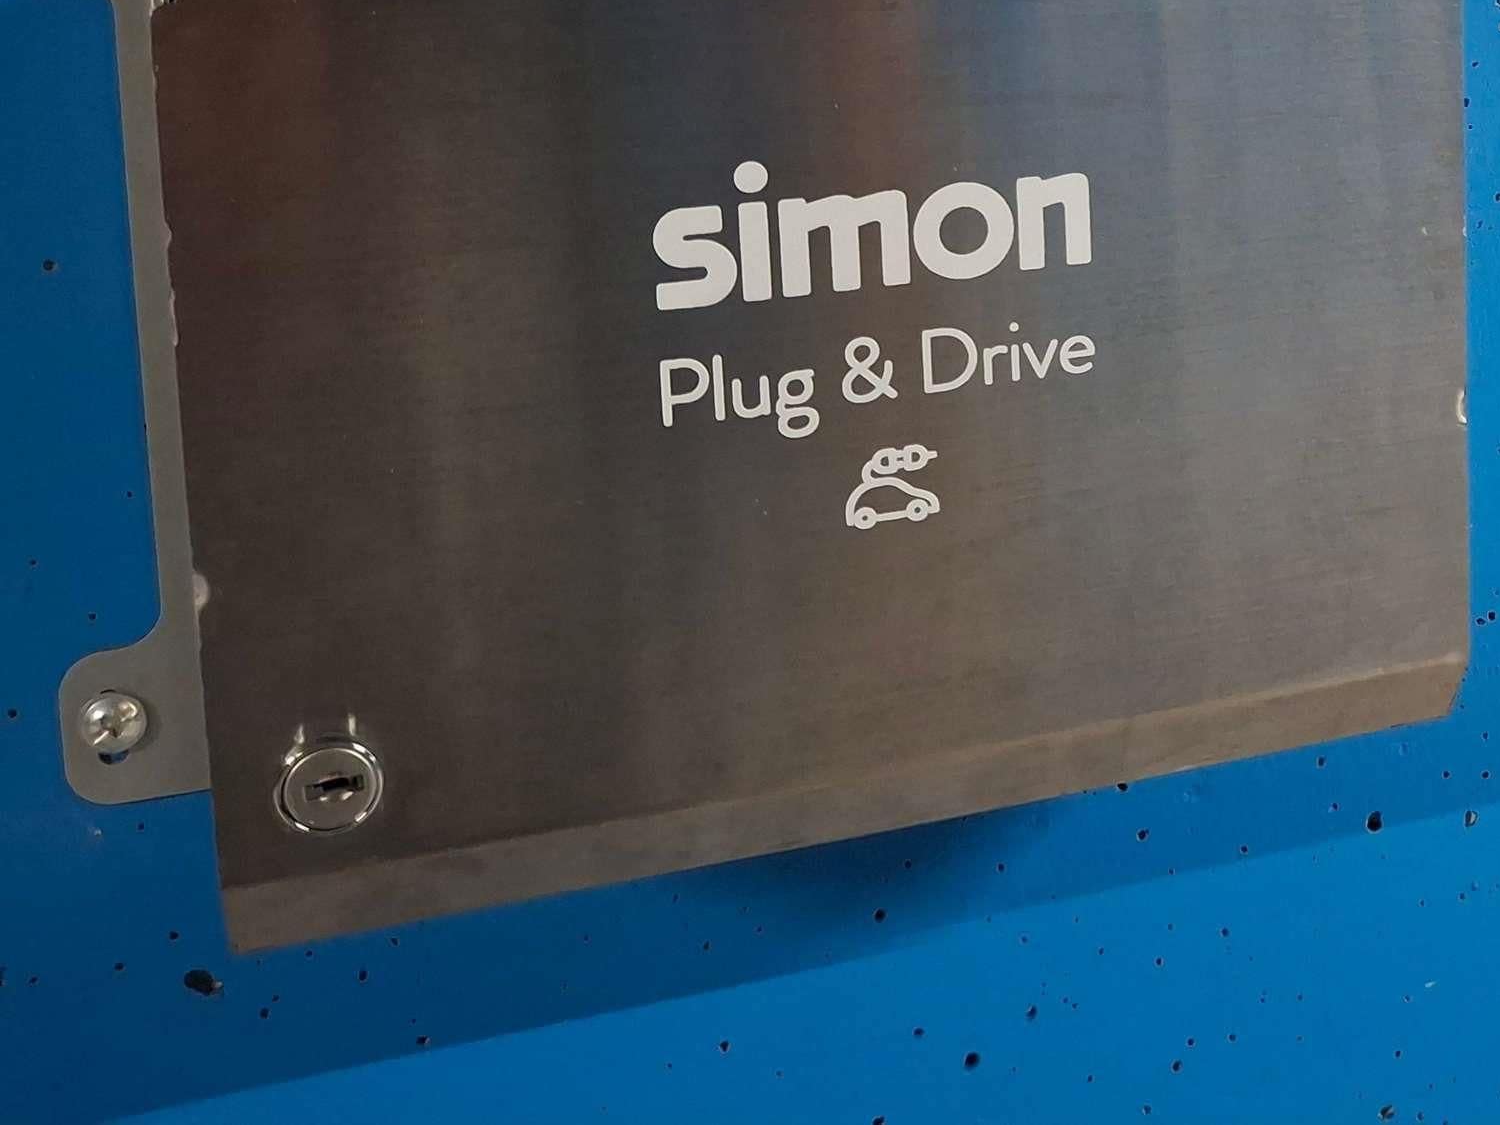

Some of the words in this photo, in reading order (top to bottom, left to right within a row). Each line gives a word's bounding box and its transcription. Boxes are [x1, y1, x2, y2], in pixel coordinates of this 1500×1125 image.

[651, 160, 1093, 311] simon
[659, 354, 820, 439] Plug
[842, 336, 898, 404] &
[921, 321, 1096, 394] Drive
